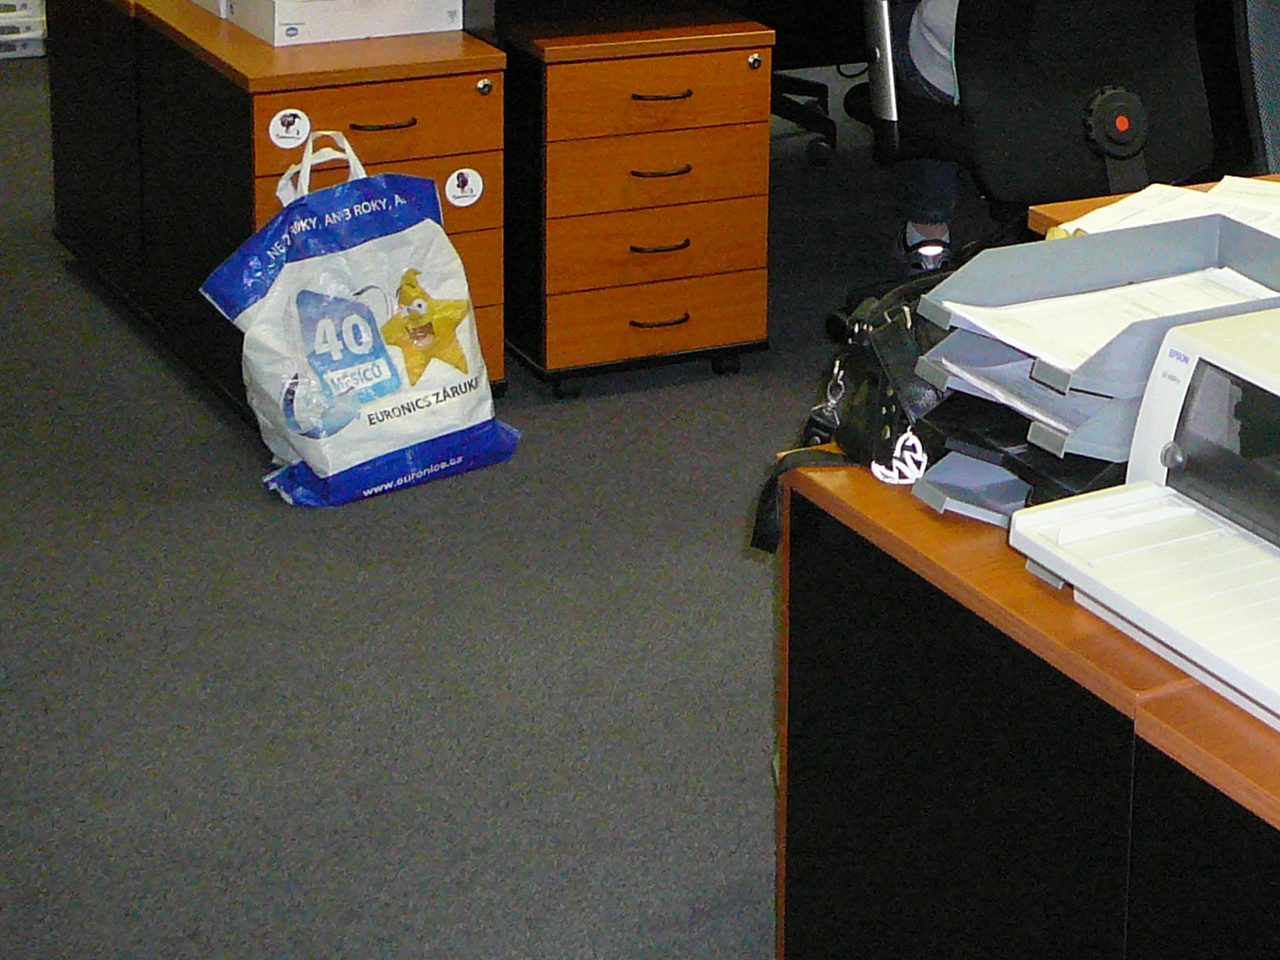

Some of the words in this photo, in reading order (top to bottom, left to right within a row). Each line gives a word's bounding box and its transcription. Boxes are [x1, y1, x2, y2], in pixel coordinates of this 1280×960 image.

[342, 208, 352, 222] 3
[314, 313, 373, 361] 40
[1168, 348, 1190, 364] EPSON
[366, 394, 433, 427] EURONICS
[362, 454, 464, 498] www.euronics.cz
